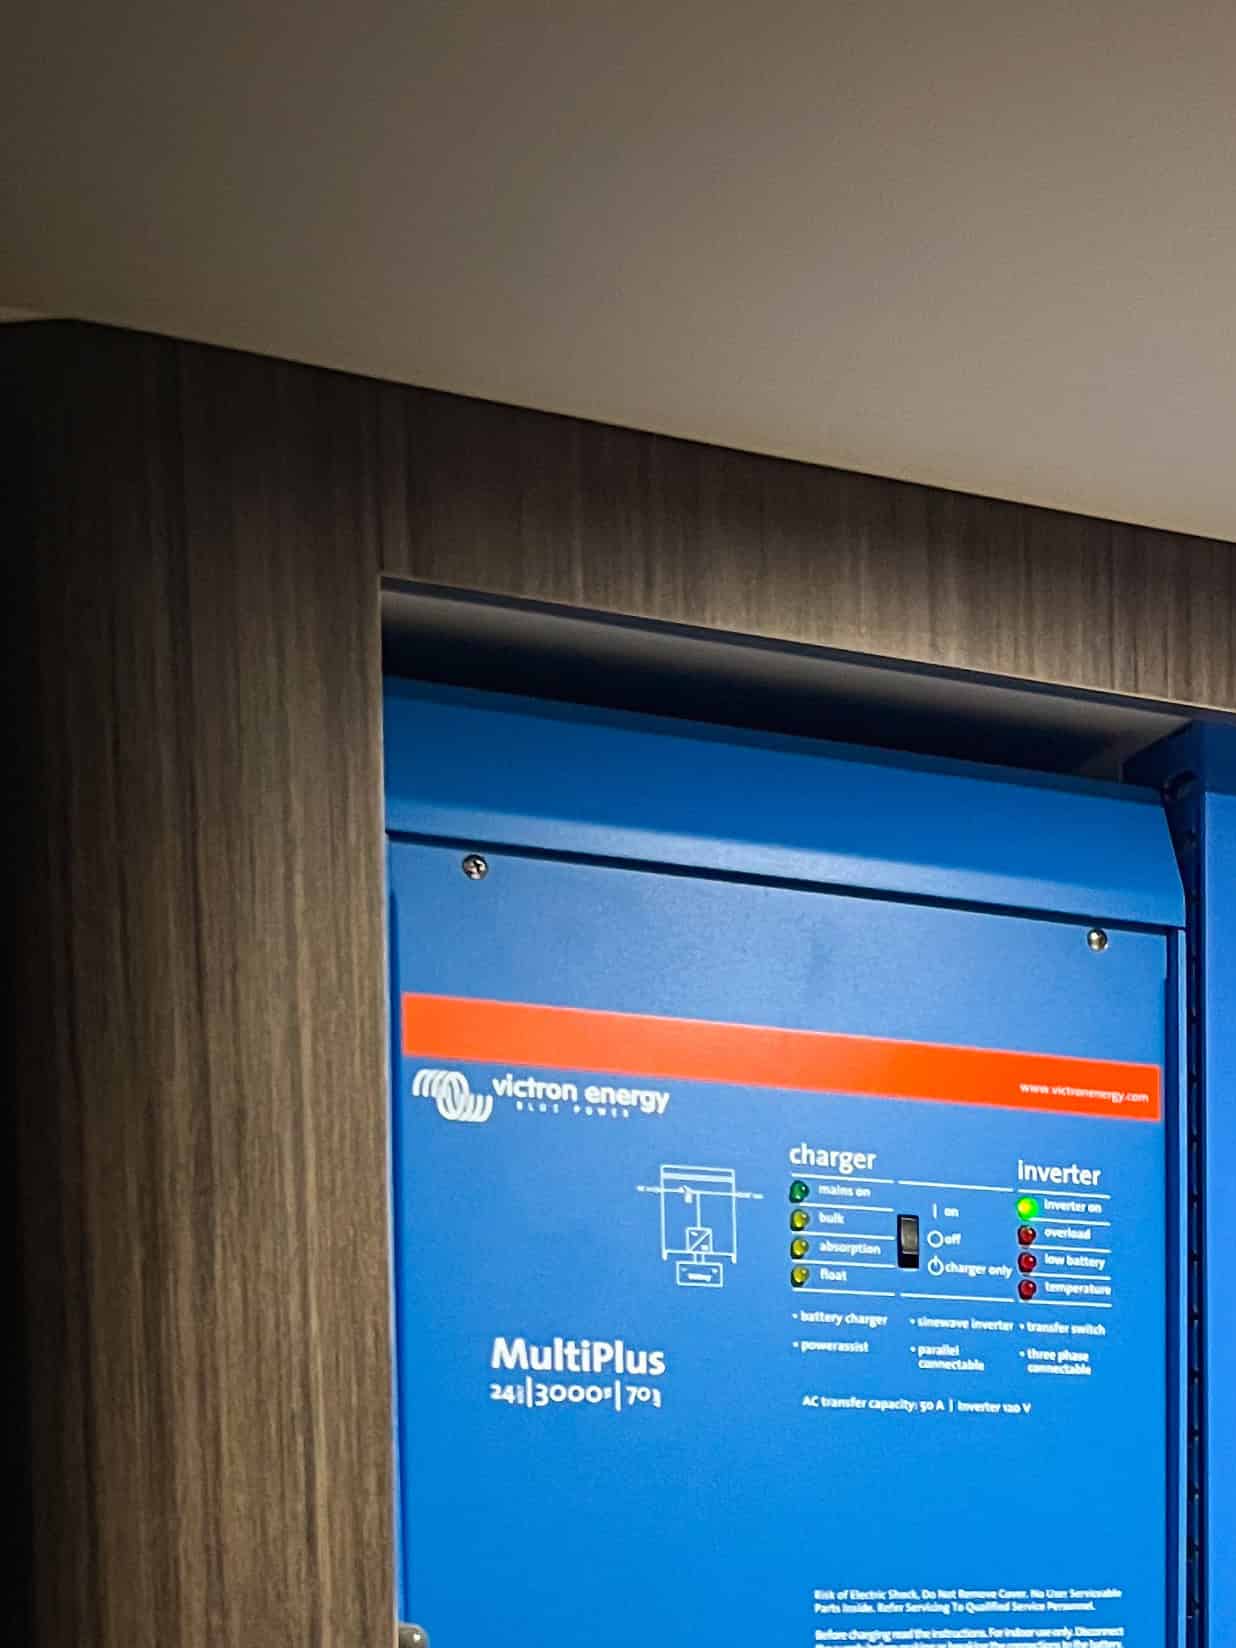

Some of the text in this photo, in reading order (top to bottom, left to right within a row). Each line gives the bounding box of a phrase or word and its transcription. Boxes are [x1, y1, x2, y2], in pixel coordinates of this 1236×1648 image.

[492, 1074, 669, 1114] victron energy
[790, 1142, 877, 1174] charger
[818, 1184, 871, 1197] mains on
[944, 1206, 959, 1216] on
[1088, 1203, 1102, 1213] on
[818, 1212, 845, 1224] bulk
[944, 1233, 961, 1245] off
[1044, 1228, 1090, 1240] overload
[820, 1240, 881, 1256] absorption
[1044, 1254, 1106, 1270] low battery
[820, 1268, 847, 1281] float
[945, 1262, 1013, 1280] charger only
[1044, 1282, 1111, 1296] temperature
[800, 1311, 888, 1328] battery charger
[1072, 1324, 1106, 1336] switch
[491, 1337, 666, 1376] MultiPlus
[918, 1344, 960, 1356] parallel
[1027, 1348, 1056, 1360] three
[802, 1396, 818, 1406] AC
[821, 1396, 866, 1408] transfer
